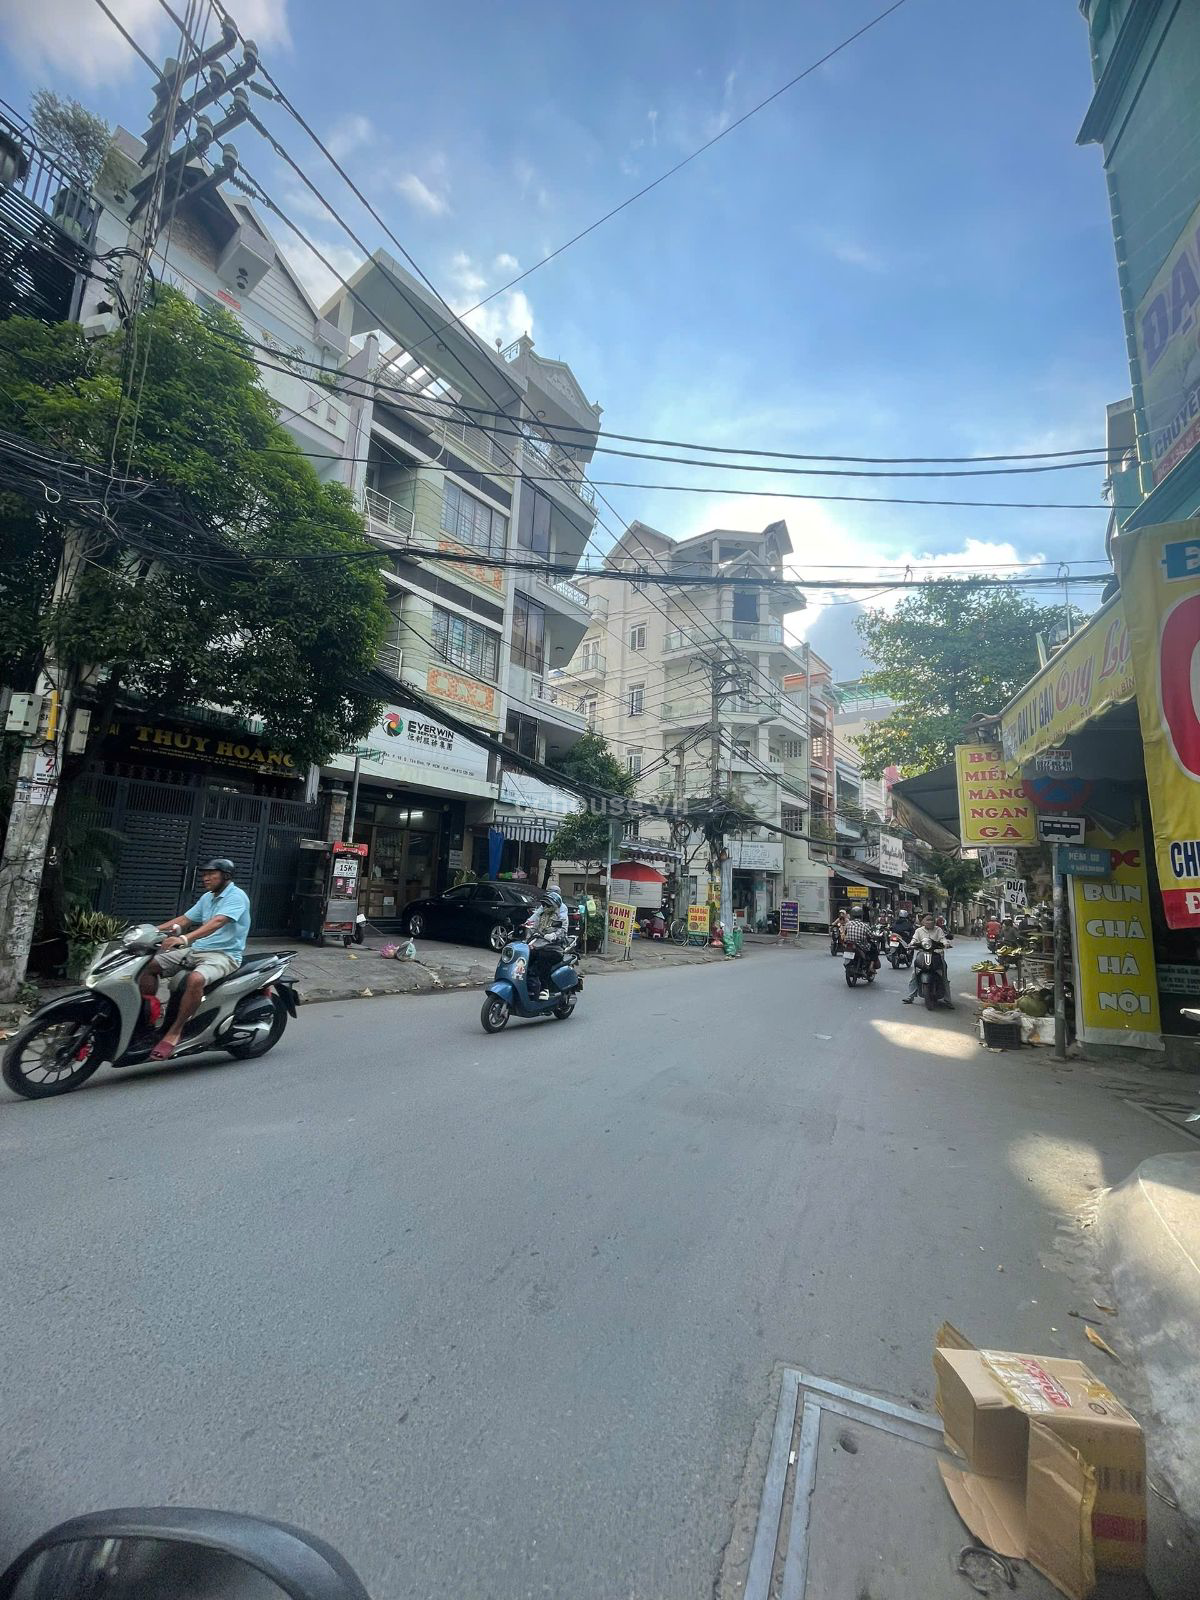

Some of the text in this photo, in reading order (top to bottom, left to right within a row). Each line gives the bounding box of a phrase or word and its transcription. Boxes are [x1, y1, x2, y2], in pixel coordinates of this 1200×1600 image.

[408, 721, 454, 740] EVERWIN
[969, 749, 1003, 763] BÚ
[968, 786, 1025, 800] MĂNG
[970, 807, 1028, 819] NGAN
[979, 823, 1022, 838] GÀ
[1170, 842, 1200, 878] CH
[340, 864, 353, 872] 15K
[1007, 879, 1023, 893] DỪA
[1082, 880, 1143, 904] BÚN
[608, 905, 630, 919] BÁNH
[1085, 915, 1147, 939] CHẢ
[1097, 952, 1141, 977] HÀ
[1098, 988, 1151, 1016] NỘI
